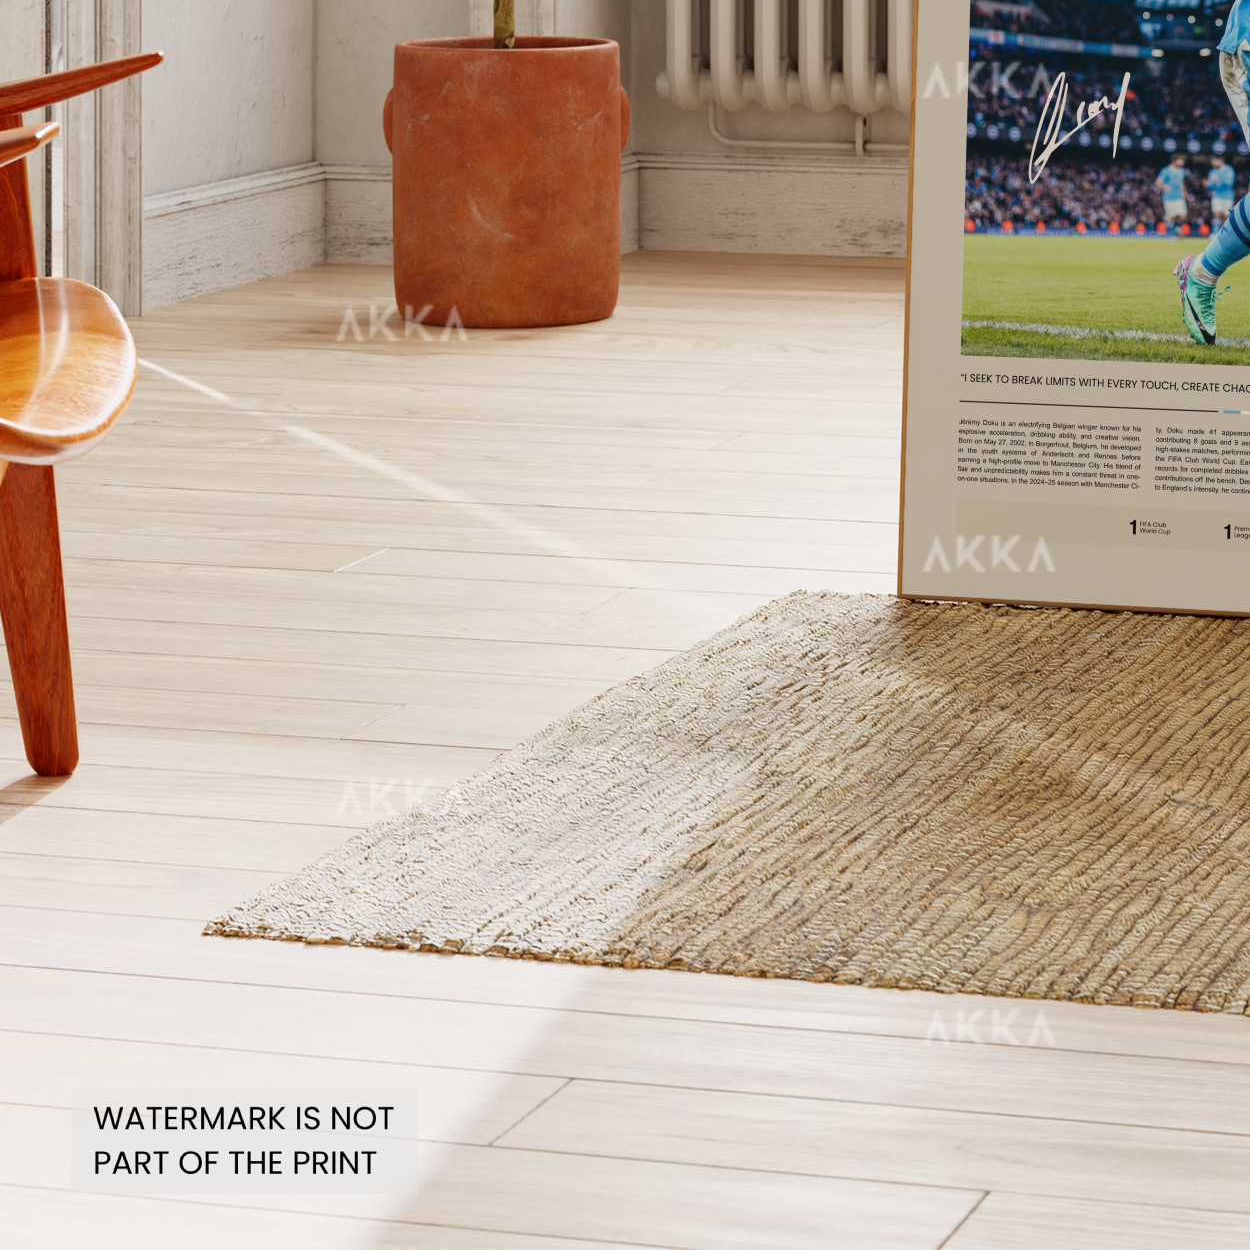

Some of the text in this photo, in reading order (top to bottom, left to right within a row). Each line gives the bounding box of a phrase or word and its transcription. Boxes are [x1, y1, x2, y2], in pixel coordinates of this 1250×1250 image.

[969, 373, 992, 383] SEEK
[995, 374, 1009, 384] TO
[1011, 375, 1043, 385] BREAK
[1045, 376, 1076, 386] LIMITS
[1078, 377, 1104, 387] WITH
[1107, 378, 1137, 388] EVERY
[1140, 380, 1179, 391] TOUCH,
[1181, 381, 1220, 392] CREATE
[1018, 421, 1050, 430] electrifying
[1052, 422, 1076, 430] Belgian
[1077, 423, 1098, 431] winger
[1130, 520, 1137, 535] 1
[1224, 524, 1231, 539] 1
